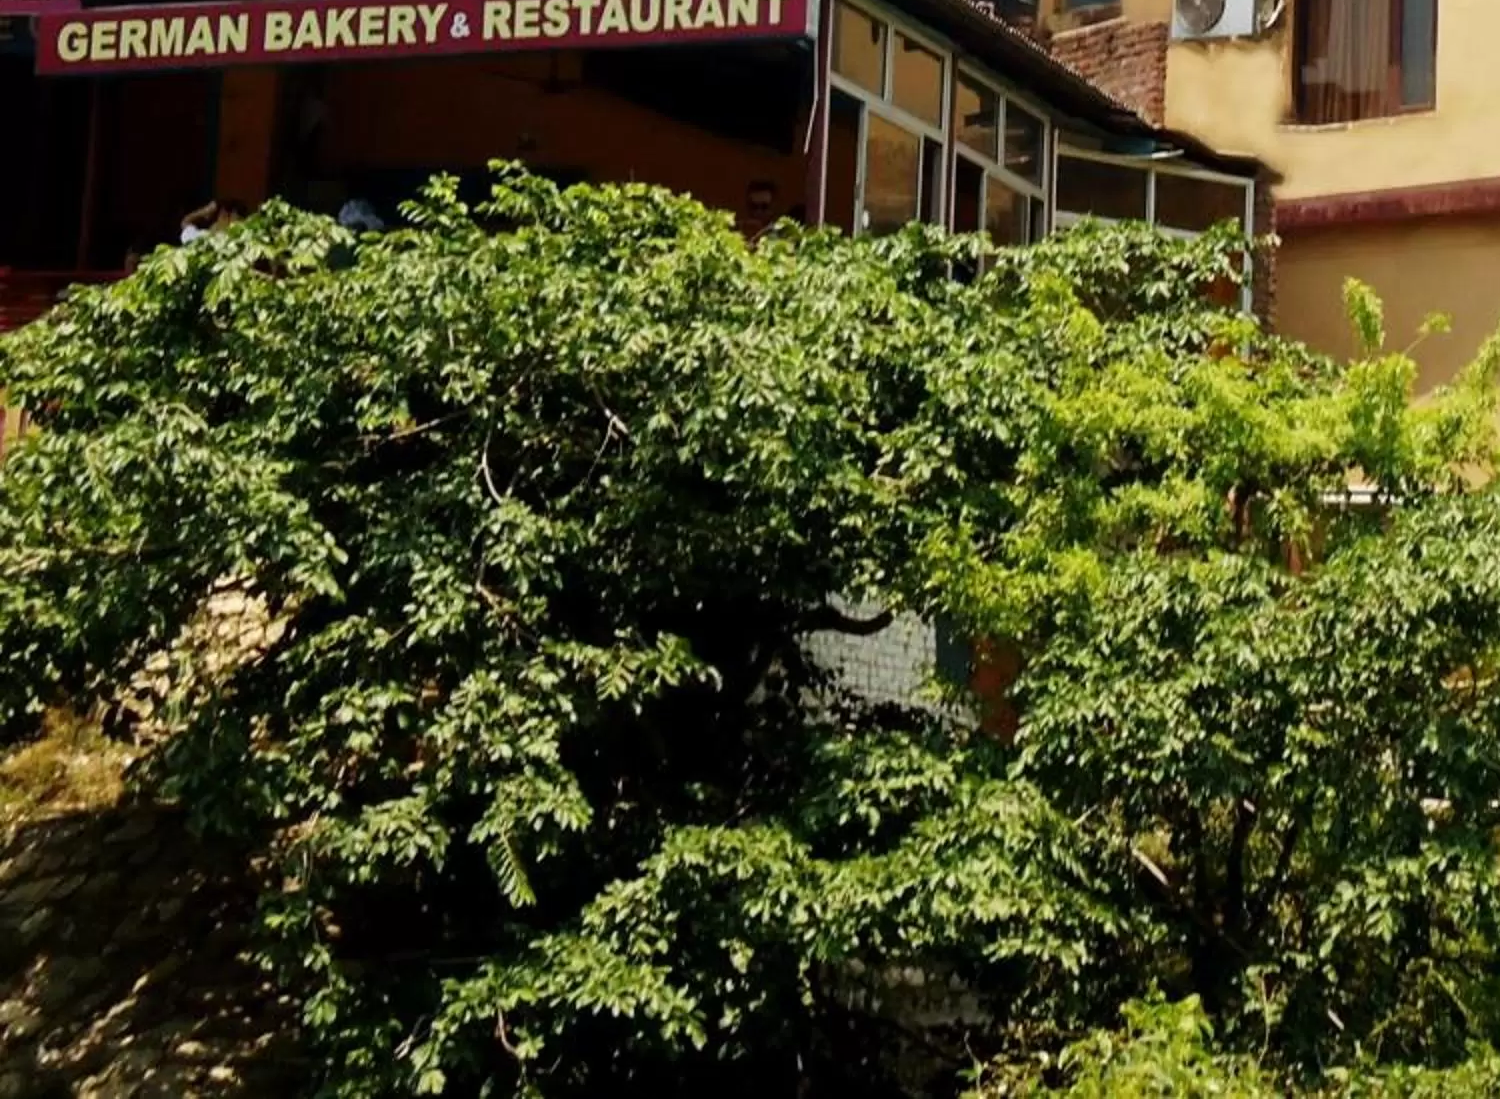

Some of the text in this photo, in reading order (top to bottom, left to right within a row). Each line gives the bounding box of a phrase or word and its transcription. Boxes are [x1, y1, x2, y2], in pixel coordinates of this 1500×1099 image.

[57, 14, 248, 62] GERMAN
[264, 3, 448, 51] BAKERY
[450, 12, 470, 39] &
